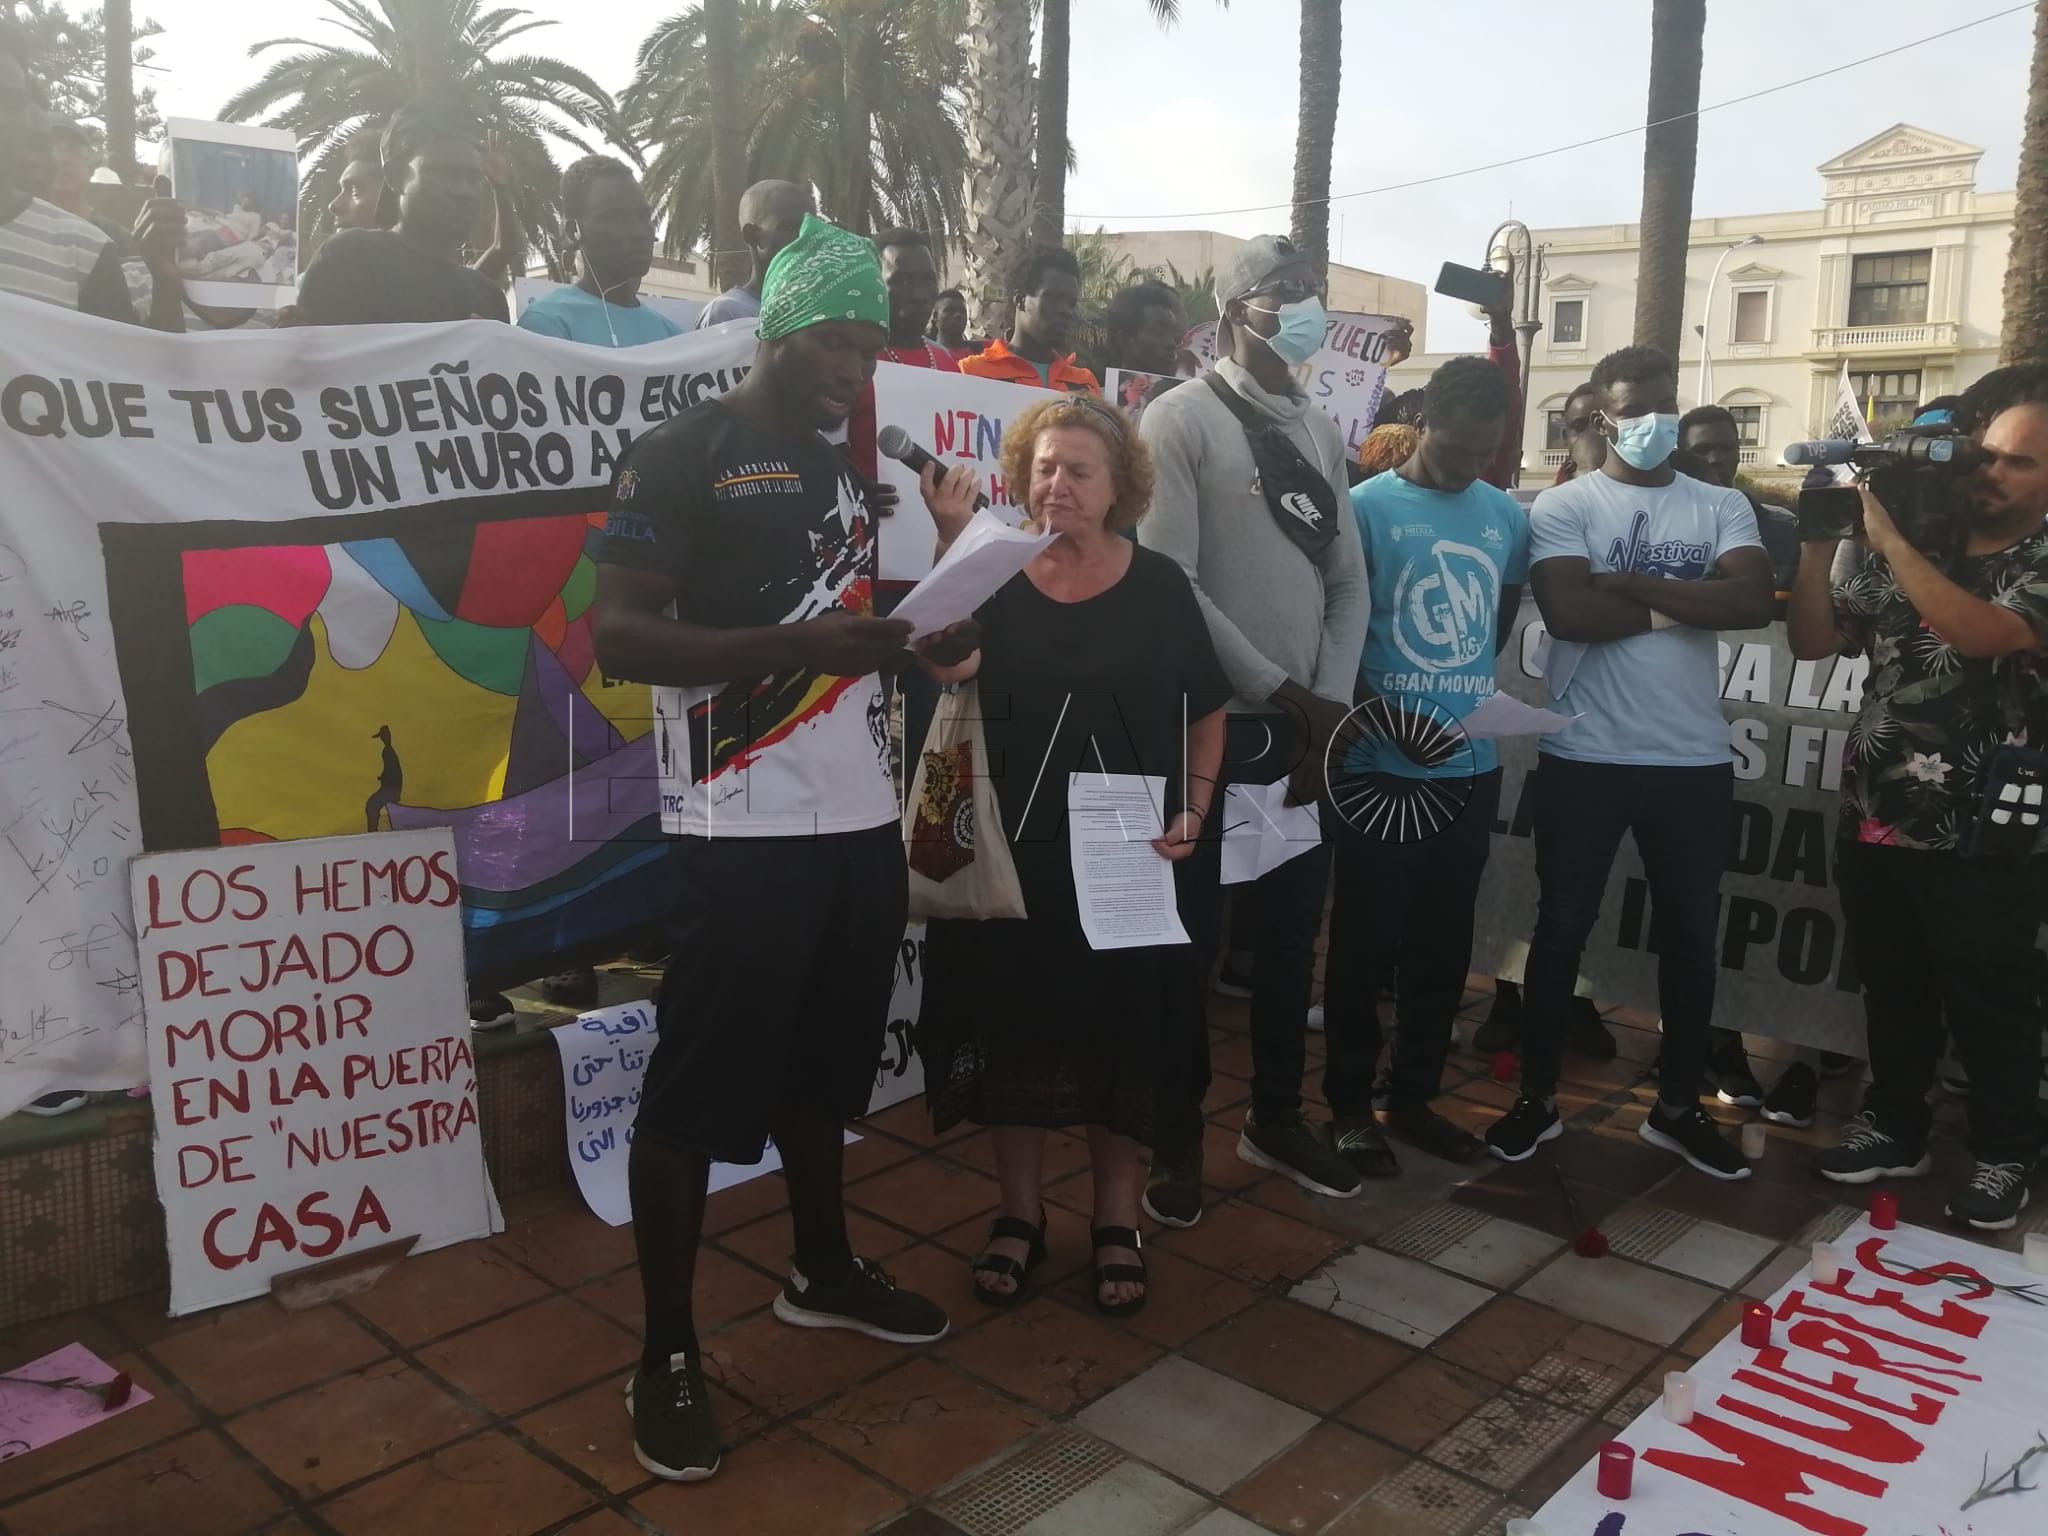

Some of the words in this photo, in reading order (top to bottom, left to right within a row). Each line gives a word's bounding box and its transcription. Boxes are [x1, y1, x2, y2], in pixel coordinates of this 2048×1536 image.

[1, 374, 154, 439] QUE
[168, 387, 302, 444] TUS
[321, 360, 549, 441] SUEÑOS
[558, 374, 625, 426] NO
[303, 448, 398, 509] UN
[421, 429, 574, 495] MURO
[1294, 493, 1323, 521] NIKE
[1383, 672, 1434, 693] GRAN
[1438, 675, 1495, 695] MOVIDA
[663, 795, 684, 813] TRC
[147, 864, 268, 930] LOS
[295, 851, 459, 915] HEMOS
[158, 924, 414, 1000] DEJADO
[172, 1069, 251, 1126] EN
[269, 1062, 330, 1105] LA
[343, 1036, 473, 1100] PUERTA
[178, 1134, 256, 1188] DE
[203, 1185, 391, 1270] CASA
[1640, 1237, 1994, 1536] MUERTES
